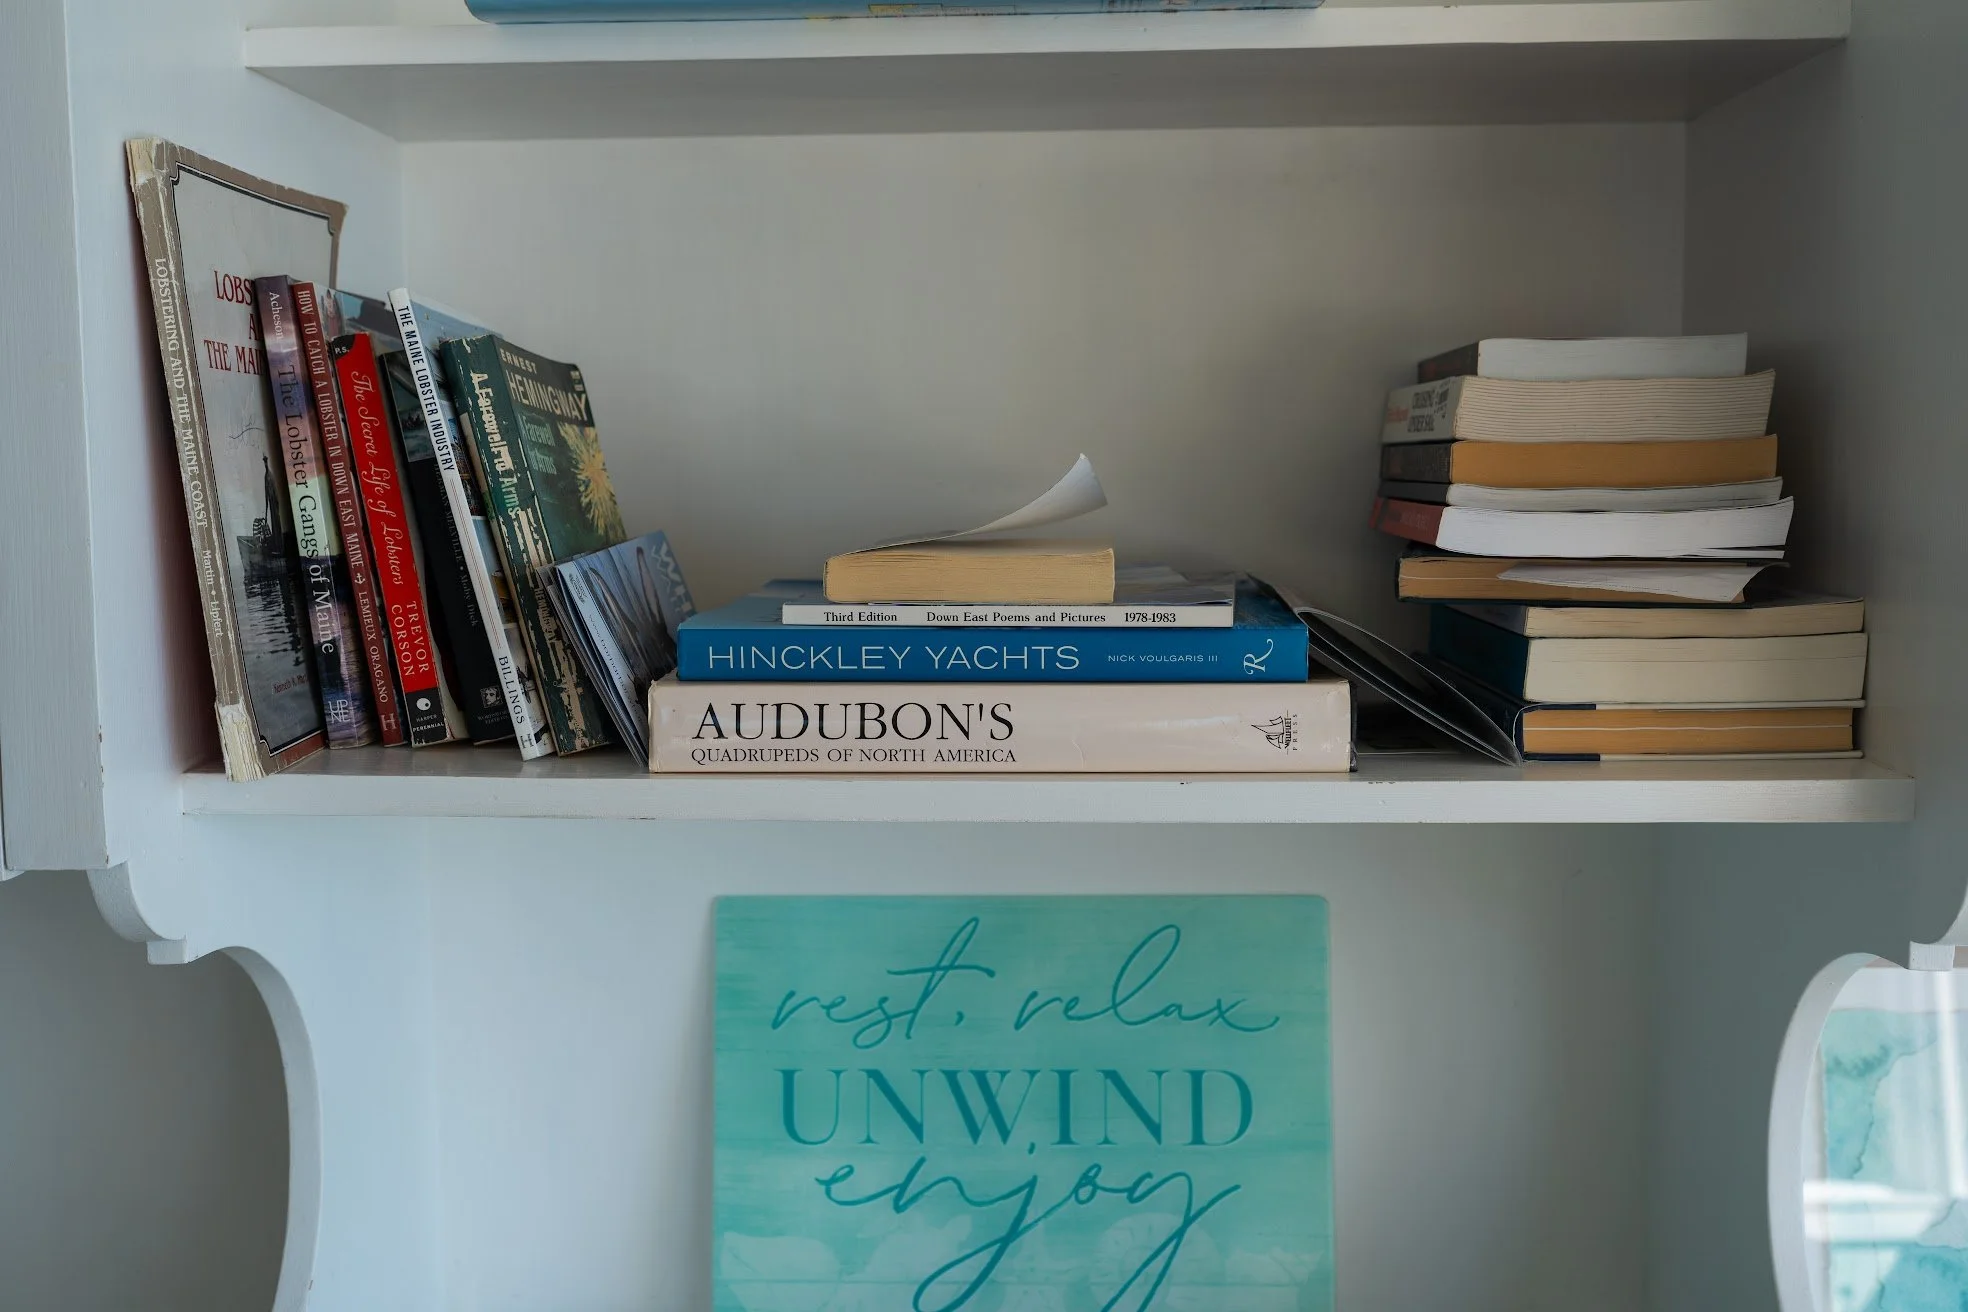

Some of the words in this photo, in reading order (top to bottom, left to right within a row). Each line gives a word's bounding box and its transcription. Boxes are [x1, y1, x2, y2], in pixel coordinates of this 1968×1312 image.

[155, 258, 180, 352] LOBSTERING
[213, 270, 256, 306] LOBS
[297, 290, 315, 316] HOW
[268, 291, 284, 340] Acheson
[303, 321, 318, 336] TO
[398, 305, 414, 327] THE
[203, 339, 232, 371] THE
[307, 339, 325, 375] CATCH
[335, 346, 349, 355] P.S.
[404, 330, 425, 367] MAINE
[499, 347, 538, 374] ERNEST
[170, 357, 185, 389] AND
[277, 364, 299, 407] The
[315, 380, 328, 389] A
[351, 371, 374, 402] The
[176, 393, 191, 424] THE
[415, 368, 438, 417] LOBSTER
[506, 369, 588, 421] HEMINGWAY
[317, 392, 339, 442] LOBSTER
[358, 406, 380, 457] Secret
[181, 428, 199, 476] MAINE
[285, 413, 309, 489] Lobster
[328, 445, 343, 458] IN
[429, 418, 456, 473] INDUSTRY
[478, 387, 507, 453] Farewell
[499, 476, 522, 519] Arms
[331, 461, 349, 495] DOWN
[361, 461, 391, 496] Life
[190, 480, 208, 528] COAST
[339, 499, 356, 528] EAST
[367, 498, 397, 518] of
[298, 495, 319, 559] Gangs
[202, 550, 216, 585] Martin
[345, 532, 364, 569] MAINE
[380, 521, 404, 586] Lobsters
[308, 564, 330, 585] of
[312, 590, 334, 654] Maine
[823, 611, 855, 623] Third
[858, 611, 898, 623] Edition
[926, 611, 960, 623] Down
[963, 611, 989, 623] East
[992, 611, 1031, 623] Poems
[1035, 611, 1056, 623] and
[1060, 611, 1106, 623] Pictures
[1124, 611, 1176, 623] 1978-1983
[358, 591, 377, 641] LEMIEUX
[369, 646, 389, 703] ORAGANO
[391, 604, 416, 677] CORSON
[406, 600, 430, 674] TREVOR
[708, 645, 911, 670] HINCKLEY
[925, 645, 1080, 670] YACHTS
[1107, 655, 1136, 663] NICK
[1138, 655, 1204, 663] VOULGARIS
[1207, 655, 1219, 663] III
[498, 655, 525, 725] BILLINGS
[412, 721, 445, 733] PERENNIAL
[415, 713, 438, 722] HARPER
[691, 701, 1014, 741] AUDUBON'S
[691, 748, 820, 766] QUADRUPEDS
[827, 748, 853, 763] OF
[860, 748, 925, 763] NORTH
[933, 748, 1017, 763] AMERICA
[771, 916, 996, 1049] rest,
[1013, 924, 1280, 1033] relax
[774, 1067, 1254, 1147] UNWIND
[815, 1141, 1242, 1312] enjoy
